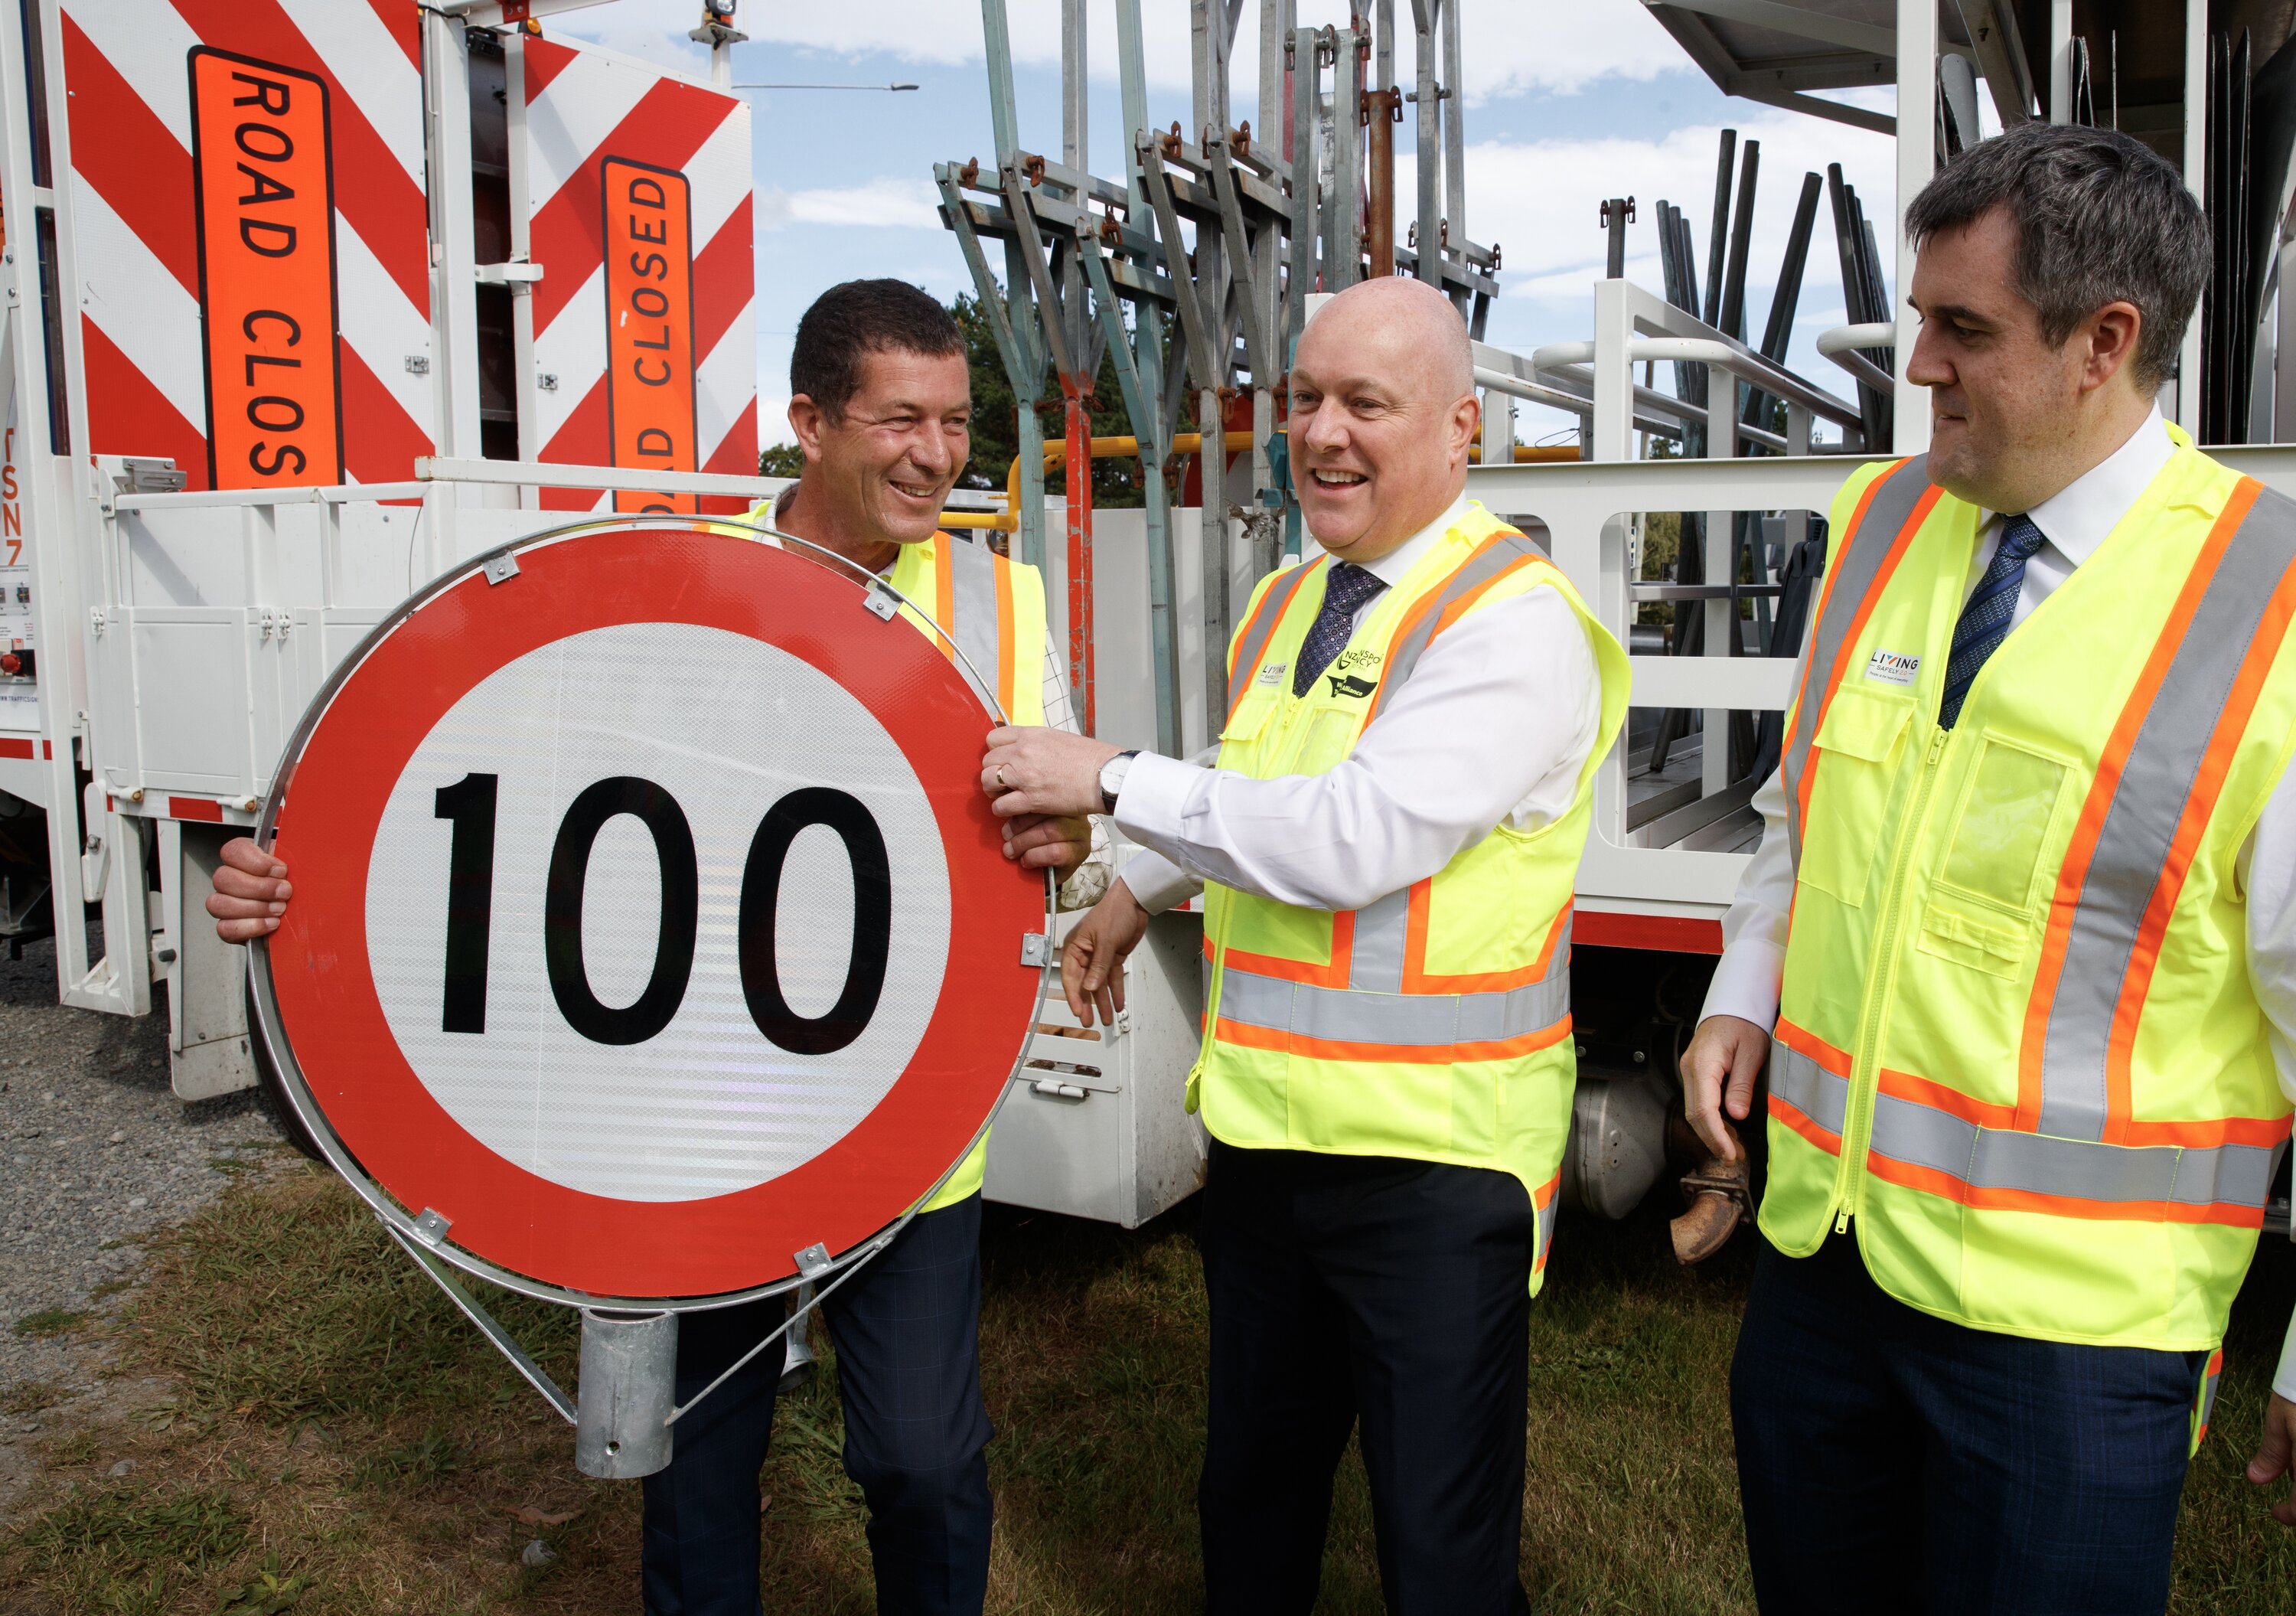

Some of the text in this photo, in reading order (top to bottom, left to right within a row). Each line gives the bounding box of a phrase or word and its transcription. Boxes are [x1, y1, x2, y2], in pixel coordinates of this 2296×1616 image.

[232, 71, 306, 488] ROAD CLOS
[629, 178, 671, 387] CLOSED
[1342, 685, 1363, 697] Alliance
[1871, 651, 1918, 670] LIVING
[1877, 664, 1899, 674] SAFELY
[435, 772, 892, 1056] 100
